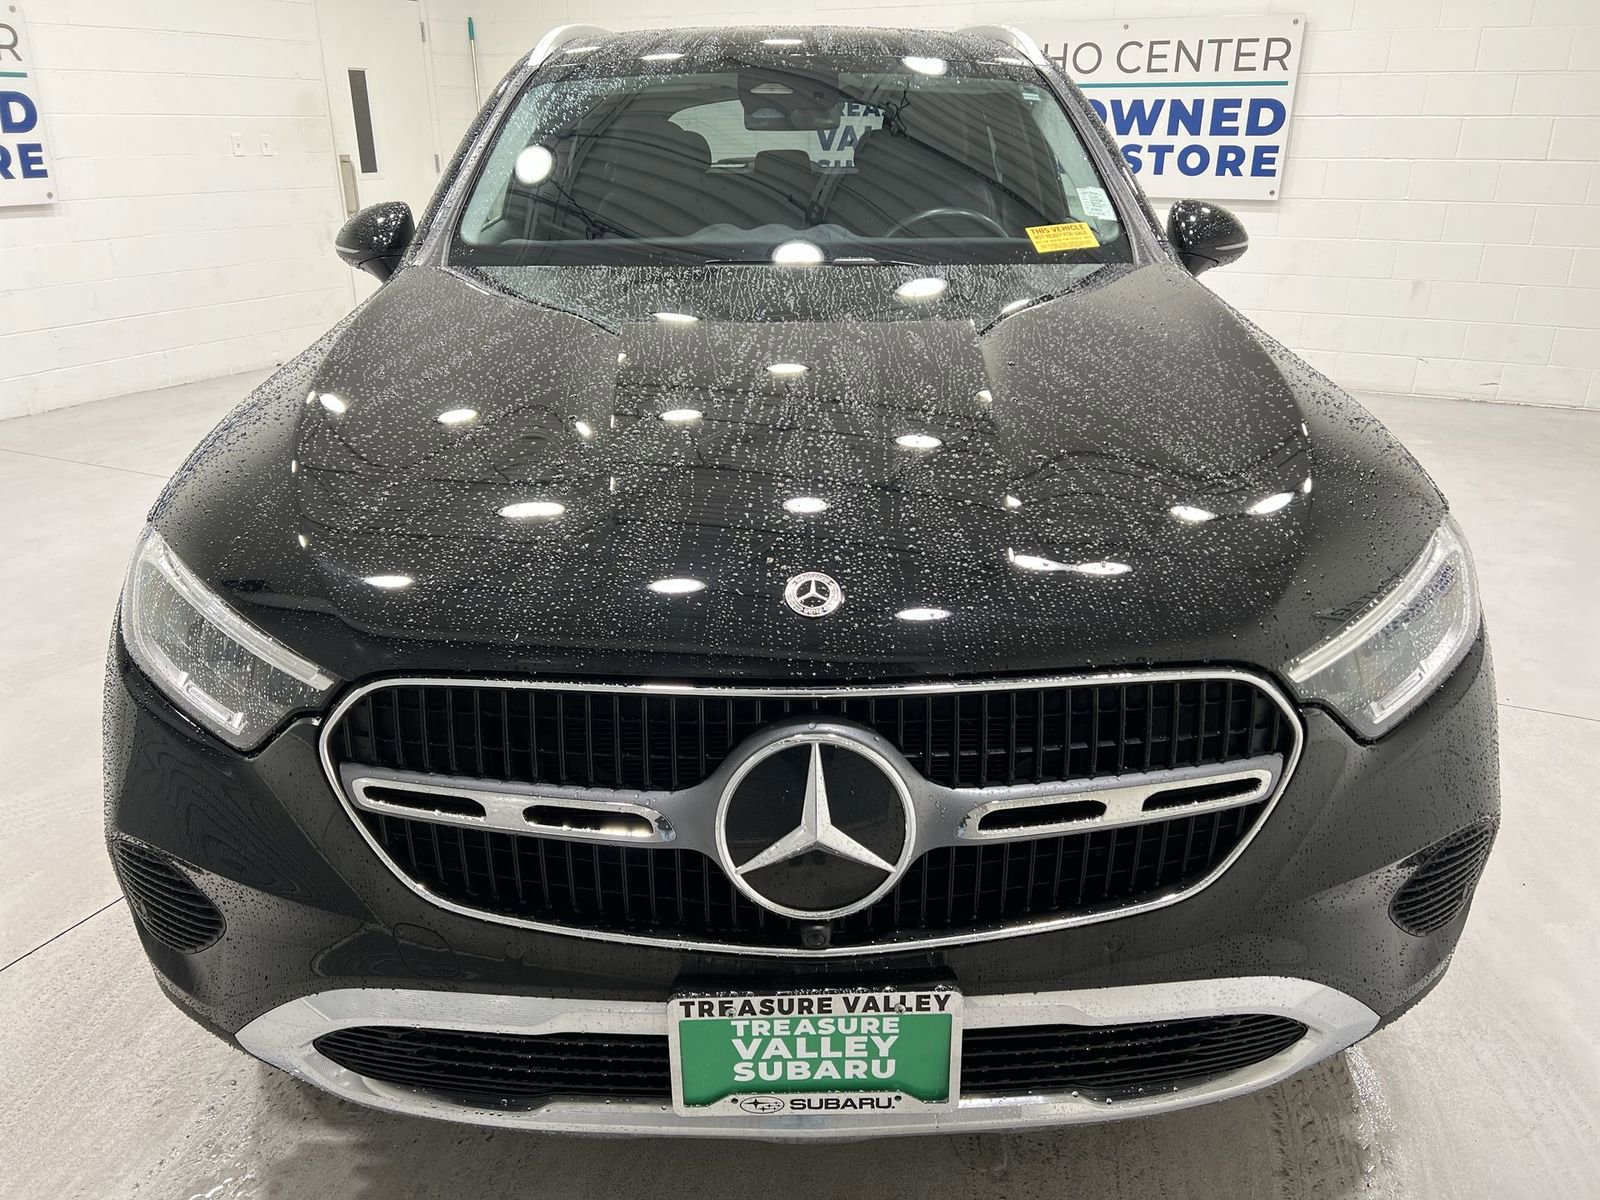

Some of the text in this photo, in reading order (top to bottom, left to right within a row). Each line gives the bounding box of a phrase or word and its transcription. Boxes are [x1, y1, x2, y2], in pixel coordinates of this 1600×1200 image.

[1116, 37, 1292, 74] CENTER
[1120, 144, 1280, 177] STORE
[1030, 224, 1086, 235] THIS VEHICLE
[680, 994, 951, 1018] TREASURE VALLEY
[731, 1017, 900, 1037] TREASURE
[731, 1035, 899, 1060] VALLEY
[733, 1059, 896, 1082] SUBARU
